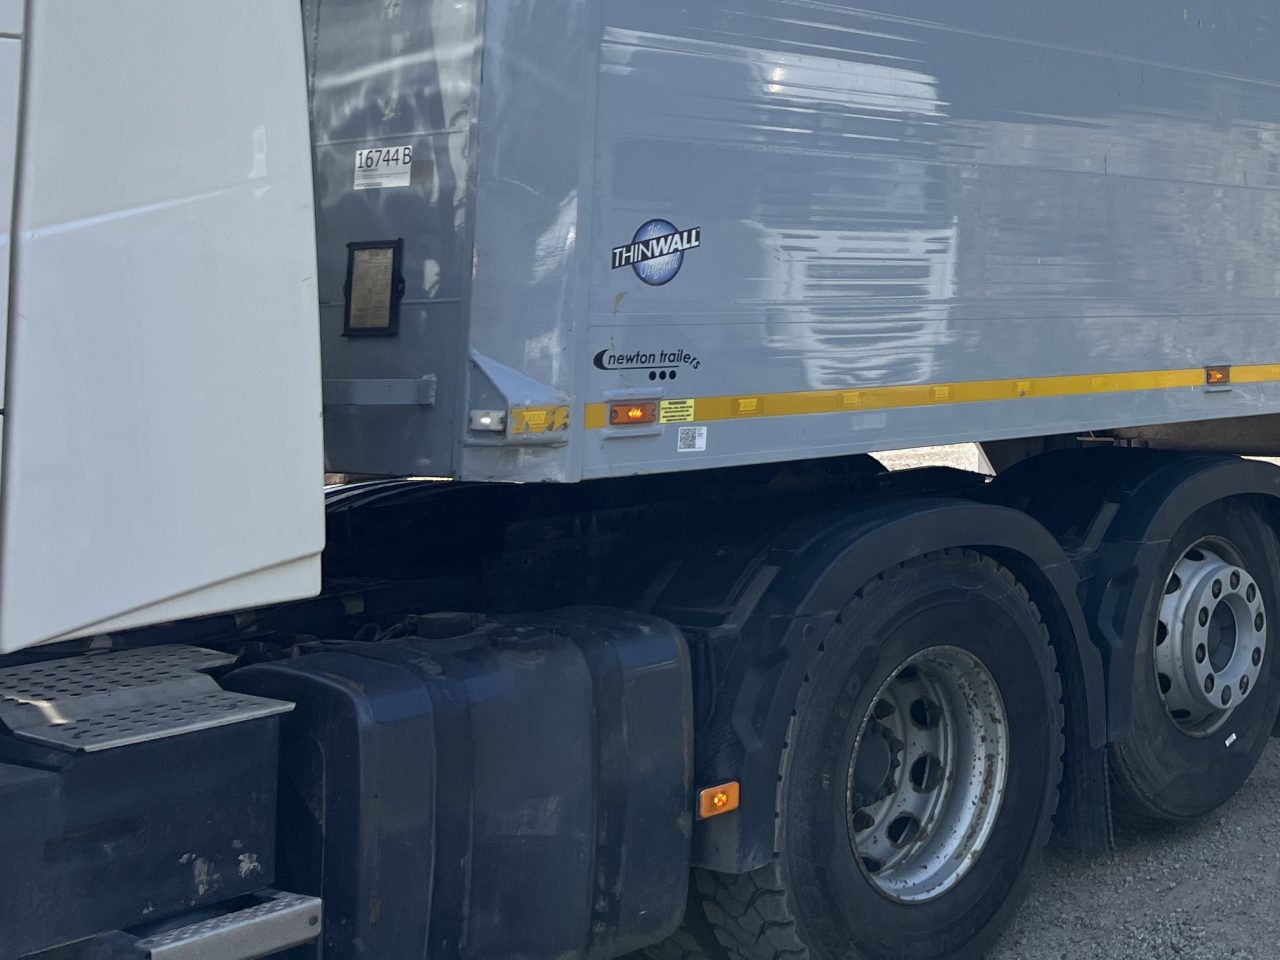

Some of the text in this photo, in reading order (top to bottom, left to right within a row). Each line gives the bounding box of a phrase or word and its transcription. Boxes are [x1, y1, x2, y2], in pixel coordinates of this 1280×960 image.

[613, 229, 699, 267] THINWALL
[608, 349, 701, 369] newton trailers
